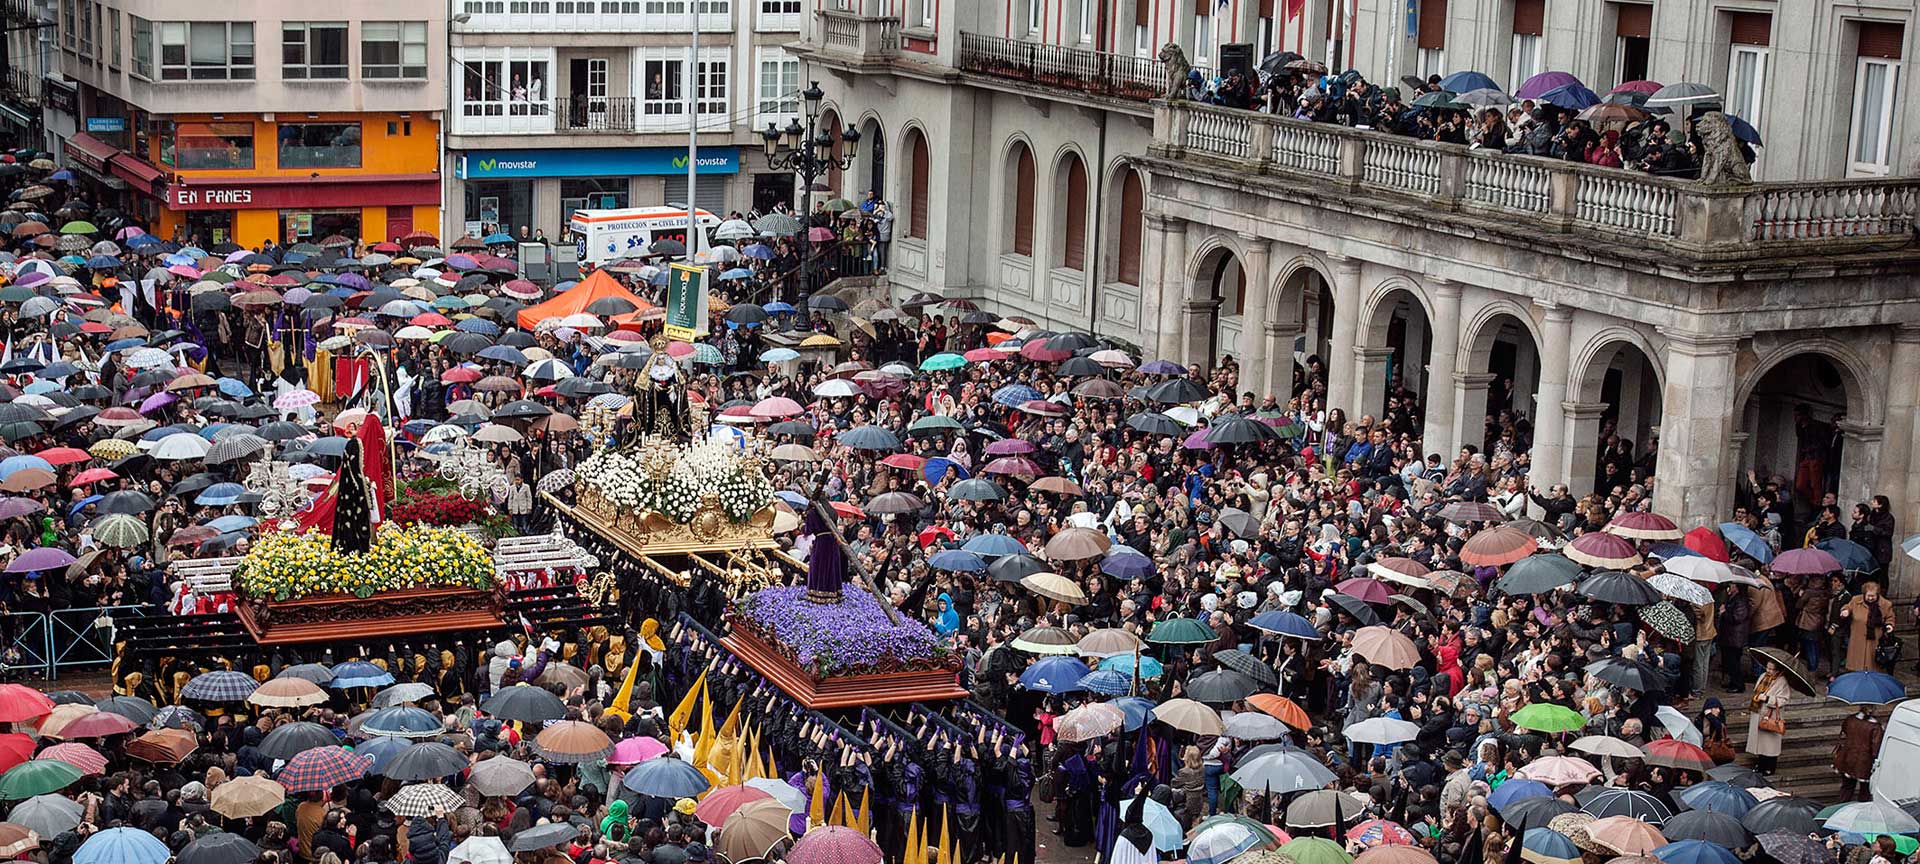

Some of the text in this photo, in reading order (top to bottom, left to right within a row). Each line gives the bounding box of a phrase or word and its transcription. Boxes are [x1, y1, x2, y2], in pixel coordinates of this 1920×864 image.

[498, 160, 537, 169] movistar
[178, 190, 198, 204] EN
[205, 190, 252, 204] PANES
